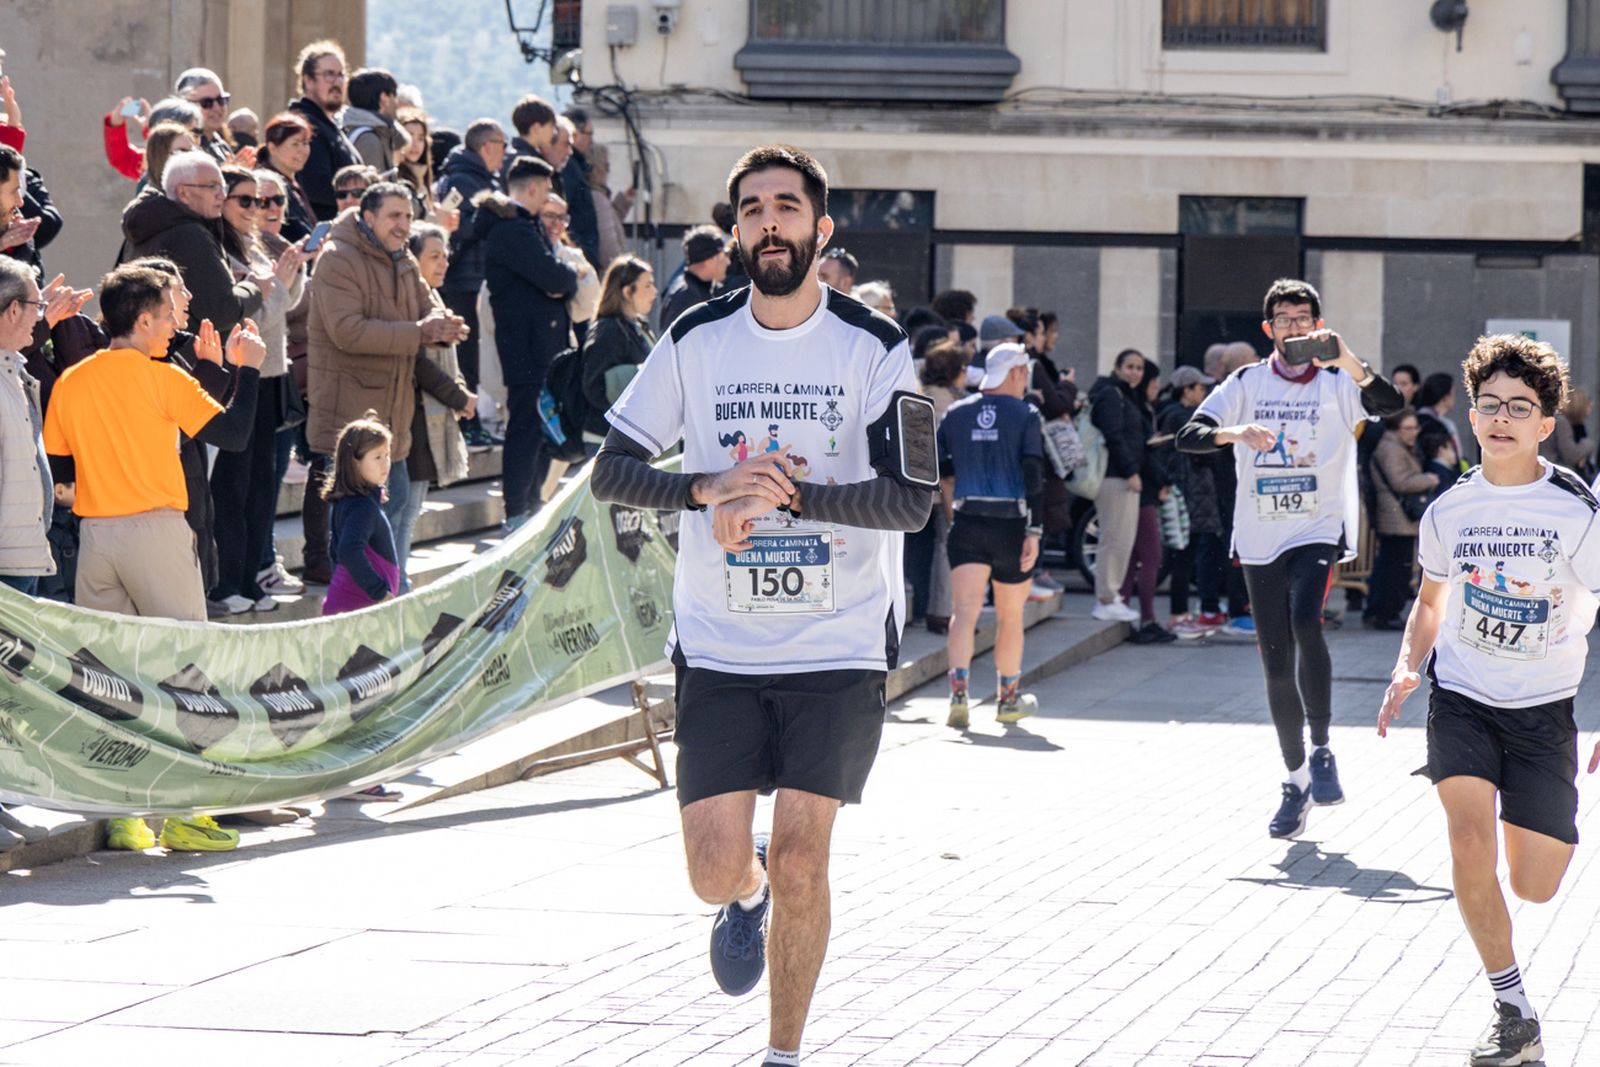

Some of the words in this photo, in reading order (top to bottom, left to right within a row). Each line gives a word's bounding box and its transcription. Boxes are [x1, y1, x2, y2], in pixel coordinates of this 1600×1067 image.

[715, 385, 726, 396] VI
[727, 383, 780, 395] CARRERA
[784, 383, 845, 397] CAMINATA
[715, 401, 756, 421] BUENA
[760, 402, 818, 421] MUERTE
[1272, 493, 1303, 511] 149
[1463, 526, 1503, 537] CARRERA
[1506, 526, 1559, 540] CAMINATA
[779, 538, 818, 548] CAMINATA
[1487, 543, 1536, 558] MUERTE
[765, 550, 801, 563] MUERTE
[748, 567, 804, 597] 150
[1504, 599, 1539, 609] CAMINATA
[1491, 605, 1523, 621] MUERTE
[1476, 616, 1527, 646] 447
